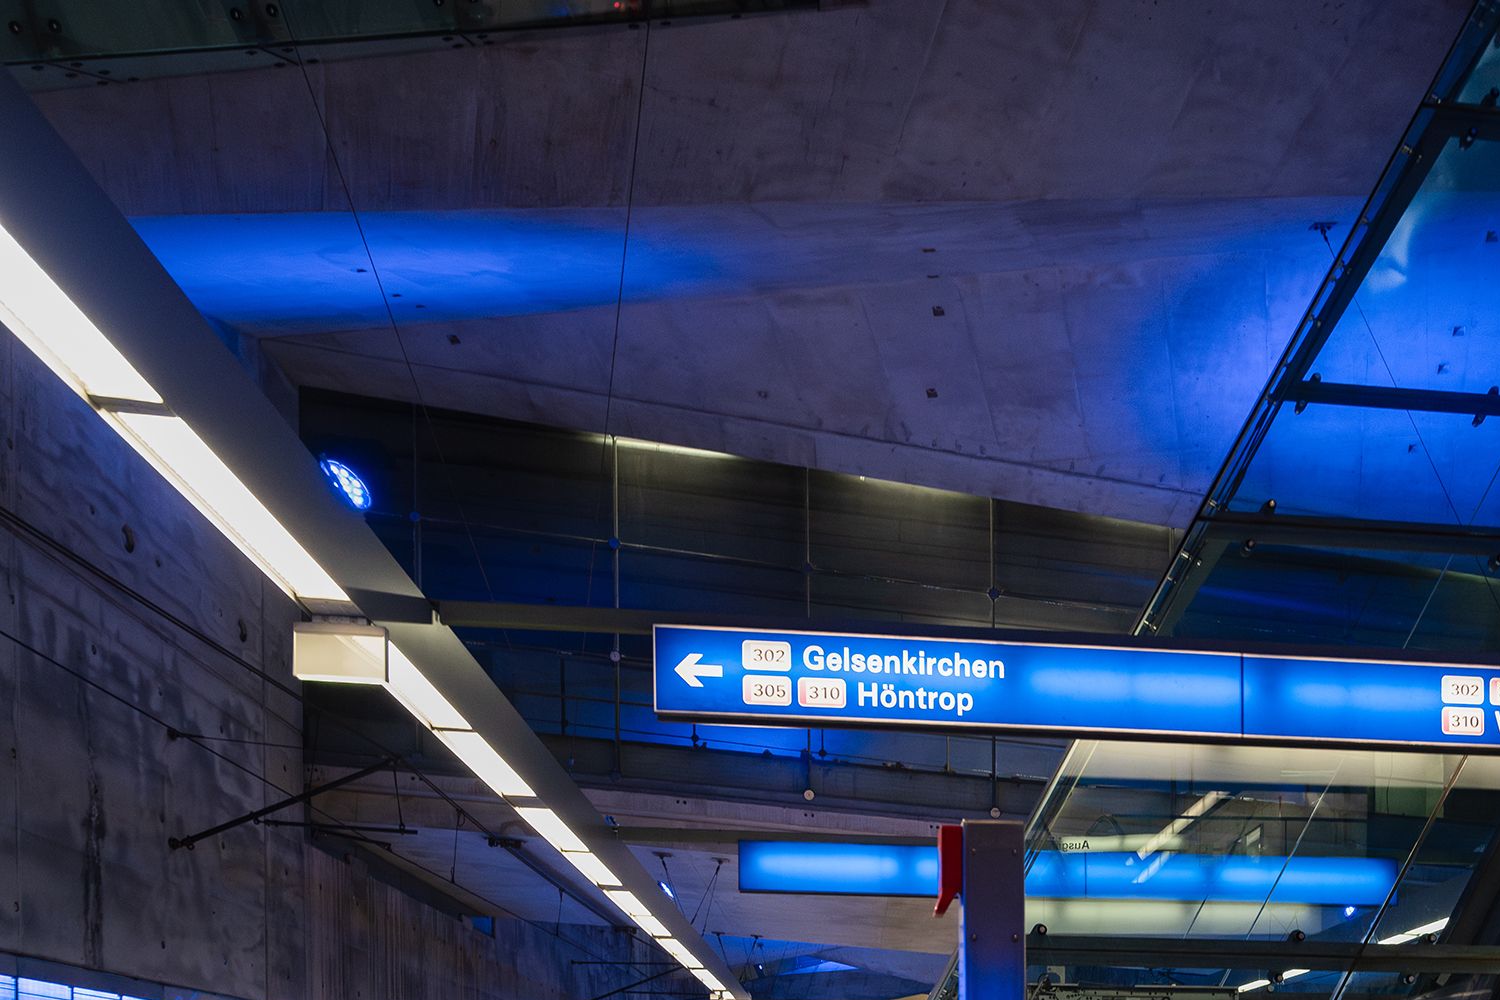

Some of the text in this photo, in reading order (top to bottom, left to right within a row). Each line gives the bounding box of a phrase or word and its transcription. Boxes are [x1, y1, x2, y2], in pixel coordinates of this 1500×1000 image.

[752, 645, 1005, 679] 302 Gelsenkirchen
[753, 682, 974, 716] 305 310 Höntrop
[1451, 683, 1479, 696] 302
[1451, 714, 1480, 728] 310
